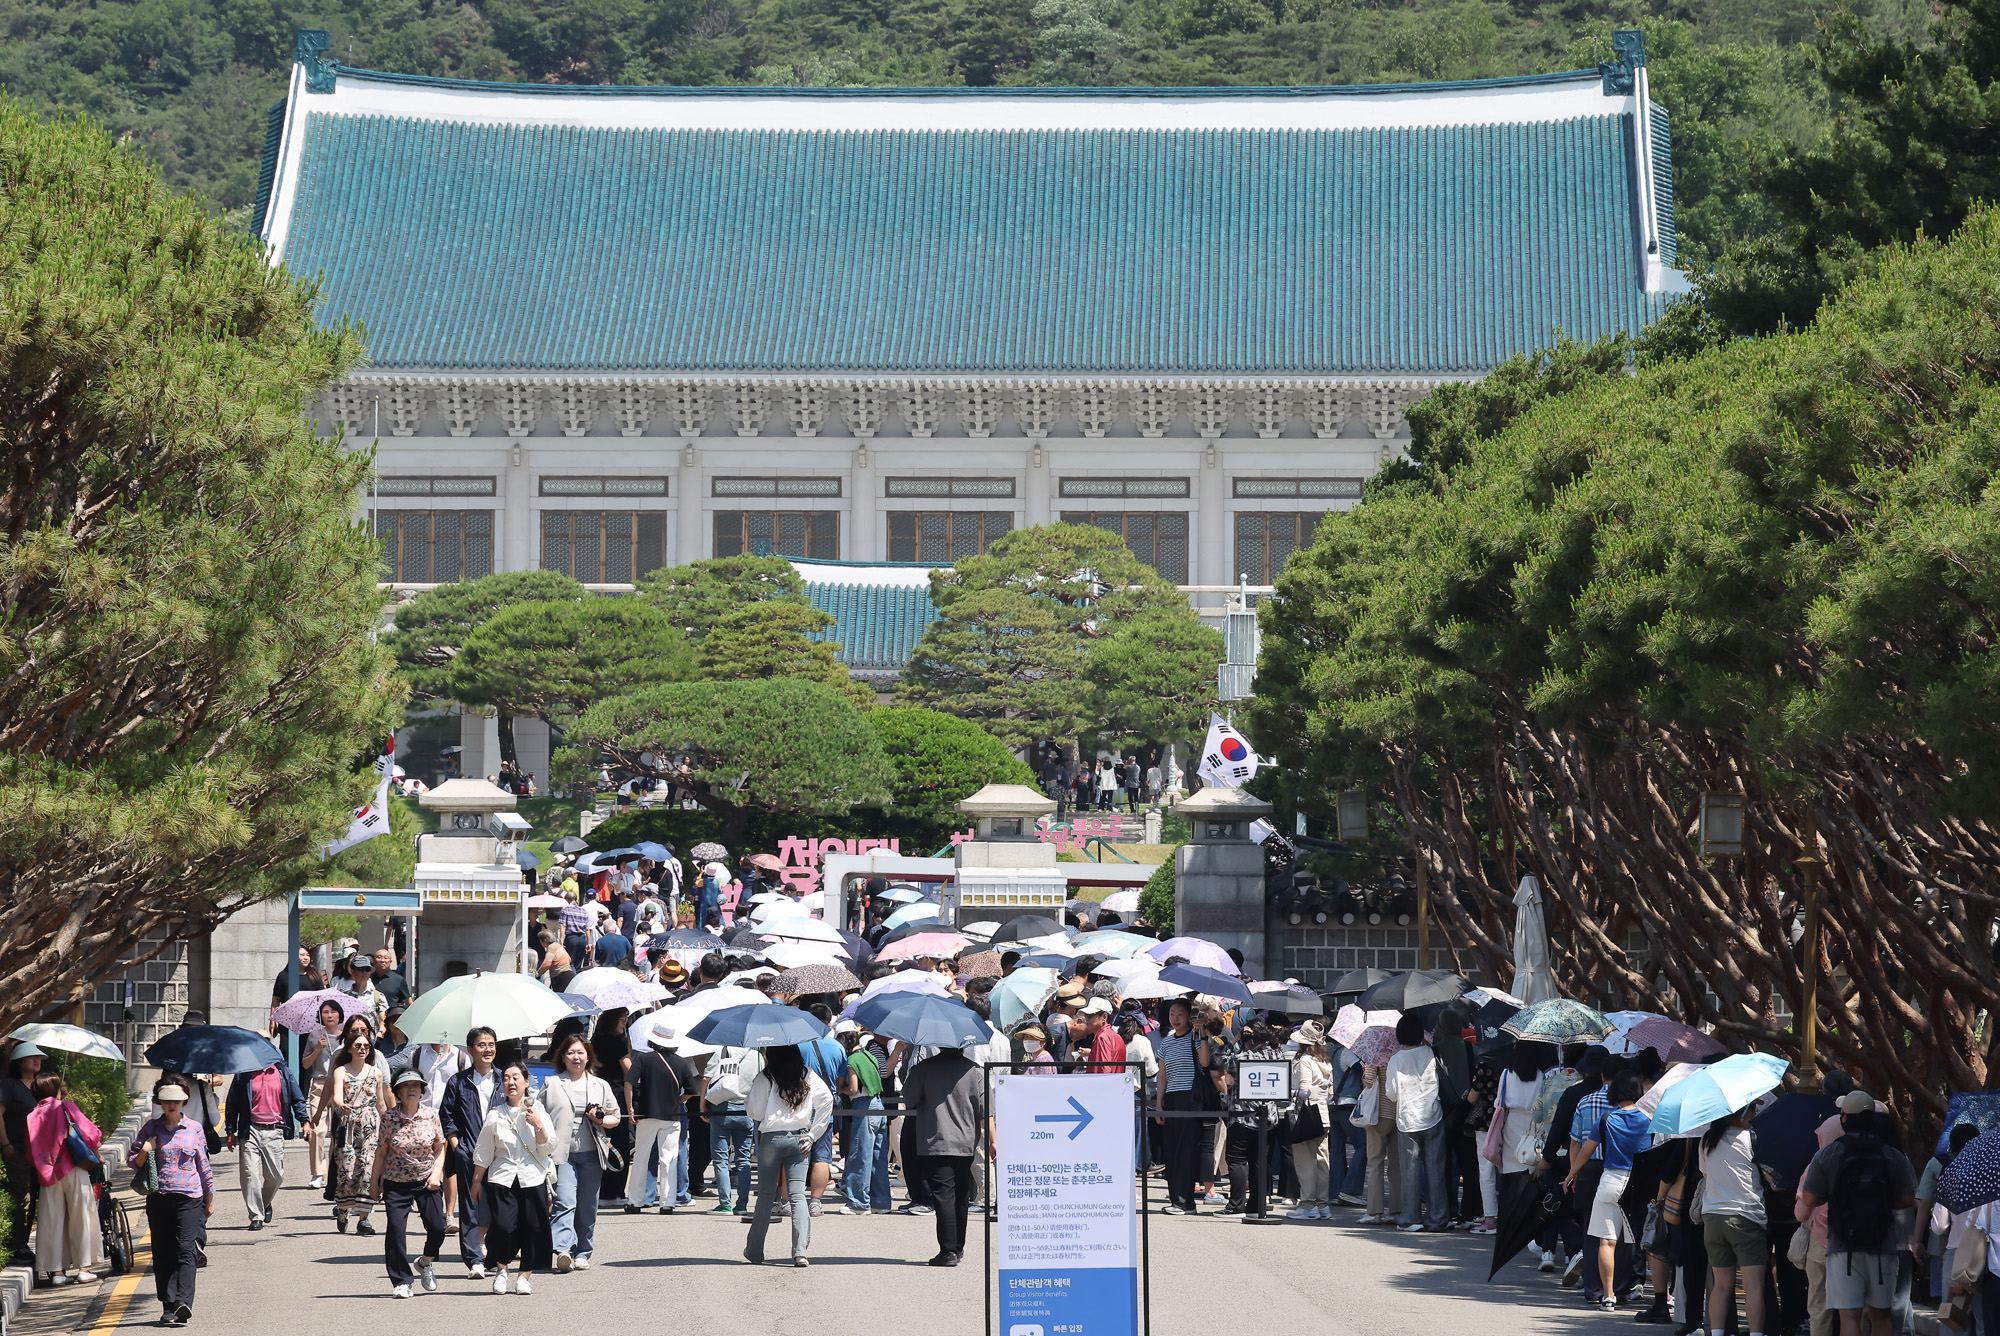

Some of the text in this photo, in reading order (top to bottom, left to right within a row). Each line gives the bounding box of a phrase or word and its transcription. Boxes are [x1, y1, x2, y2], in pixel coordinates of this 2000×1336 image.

[1071, 815, 1124, 848] 품으로
[1030, 1131, 1054, 1140] 220m
[1007, 1163, 1102, 1174] 단체(11~50인)는 춘추문,
[1007, 1175, 1113, 1186] 개인은 정문 또는 춘추문으로
[1007, 1188, 1058, 1199] 입장해주세요
[1007, 1204, 1029, 1212] Groups
[1112, 1203, 1125, 1211] only
[1009, 1277, 1071, 1289] 단체관람객 혜택
[1053, 1324, 1083, 1333] 빠른 입장
